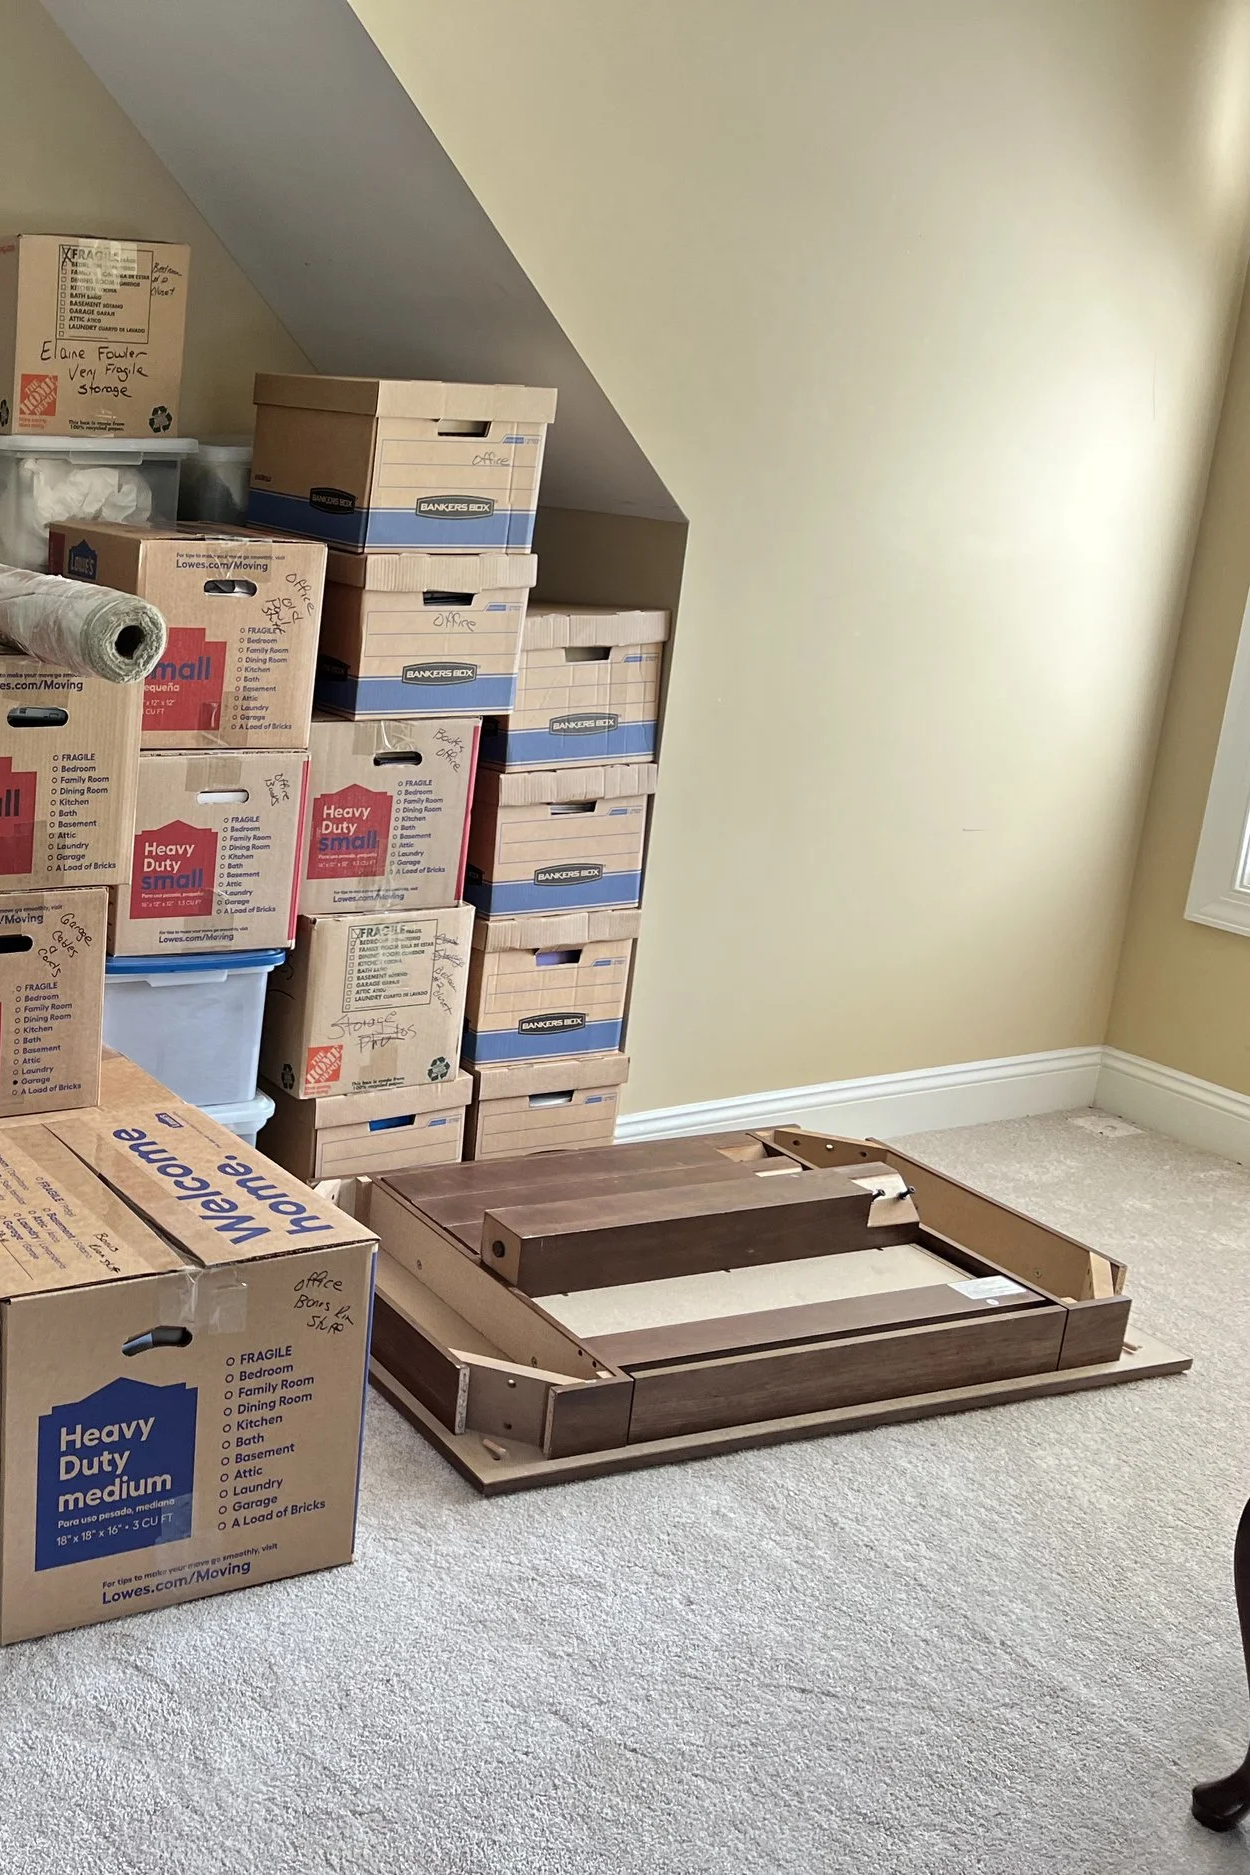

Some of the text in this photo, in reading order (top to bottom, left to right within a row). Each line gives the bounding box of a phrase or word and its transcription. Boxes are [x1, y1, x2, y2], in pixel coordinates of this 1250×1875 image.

[40, 340, 85, 360] Elaine
[69, 364, 97, 380] Very
[25, 379, 40, 394] THE
[20, 375, 58, 415] HOME
[34, 390, 57, 415] DEPOT
[420, 503, 491, 512] BANKERS BOX
[176, 559, 268, 572] Lowes.com/Moving
[150, 656, 211, 680] mall
[406, 669, 473, 678] BANKERS BOX
[144, 683, 179, 692] equeña
[553, 718, 615, 730] BANKERS BOX
[60, 788, 85, 796] Dining
[323, 805, 370, 820] Heavy
[58, 820, 97, 828] Basement
[322, 821, 357, 835] Duty
[318, 830, 377, 852] small
[145, 842, 195, 857] Heavy
[143, 858, 181, 873] Duty
[141, 867, 203, 890] small
[538, 869, 599, 881] BANKERS BOX
[159, 932, 234, 944] Lowes.com/Moving
[25, 982, 58, 992] FRAGILE
[25, 994, 59, 1002] Bedroom
[24, 1005, 50, 1013] Family
[24, 1013, 71, 1023] Dining Room
[522, 1018, 582, 1030] BANKERS BOX
[23, 1026, 53, 1034] Kitchen
[23, 1045, 61, 1054] Basement
[22, 1066, 54, 1075] Laundry
[21, 1077, 50, 1085] Garage
[28, 1086, 47, 1094] Load
[59, 1083, 81, 1091] Bricks
[112, 1128, 271, 1245] Welcome
[241, 1345, 292, 1365] FRAGILE
[239, 1364, 294, 1381] Bedroom
[238, 1376, 314, 1398] Family Room
[238, 1393, 312, 1415] Dining Room
[237, 1415, 283, 1431] Kitchen
[60, 1417, 155, 1452] Heavy
[236, 1434, 264, 1448] Bath
[235, 1443, 295, 1464] Basement
[60, 1450, 130, 1480] Duty
[234, 1467, 263, 1480] Attic
[58, 1474, 171, 1512] medium
[233, 1478, 283, 1496] Laundry
[233, 1496, 278, 1512] Garage
[58, 1499, 175, 1528] Para uso pesado, mediana
[232, 1500, 326, 1528] A Load of Bricks
[133, 1520, 139, 1530] 3
[142, 1516, 158, 1527] CU
[161, 1513, 173, 1523] FT
[102, 1580, 115, 1589] For
[117, 1577, 132, 1585] tips
[144, 1570, 166, 1579] make
[168, 1564, 186, 1575] your
[188, 1560, 210, 1569] move
[211, 1557, 221, 1565] go
[262, 1542, 278, 1552] visit
[102, 1561, 251, 1604] Lowes.com/Moving
